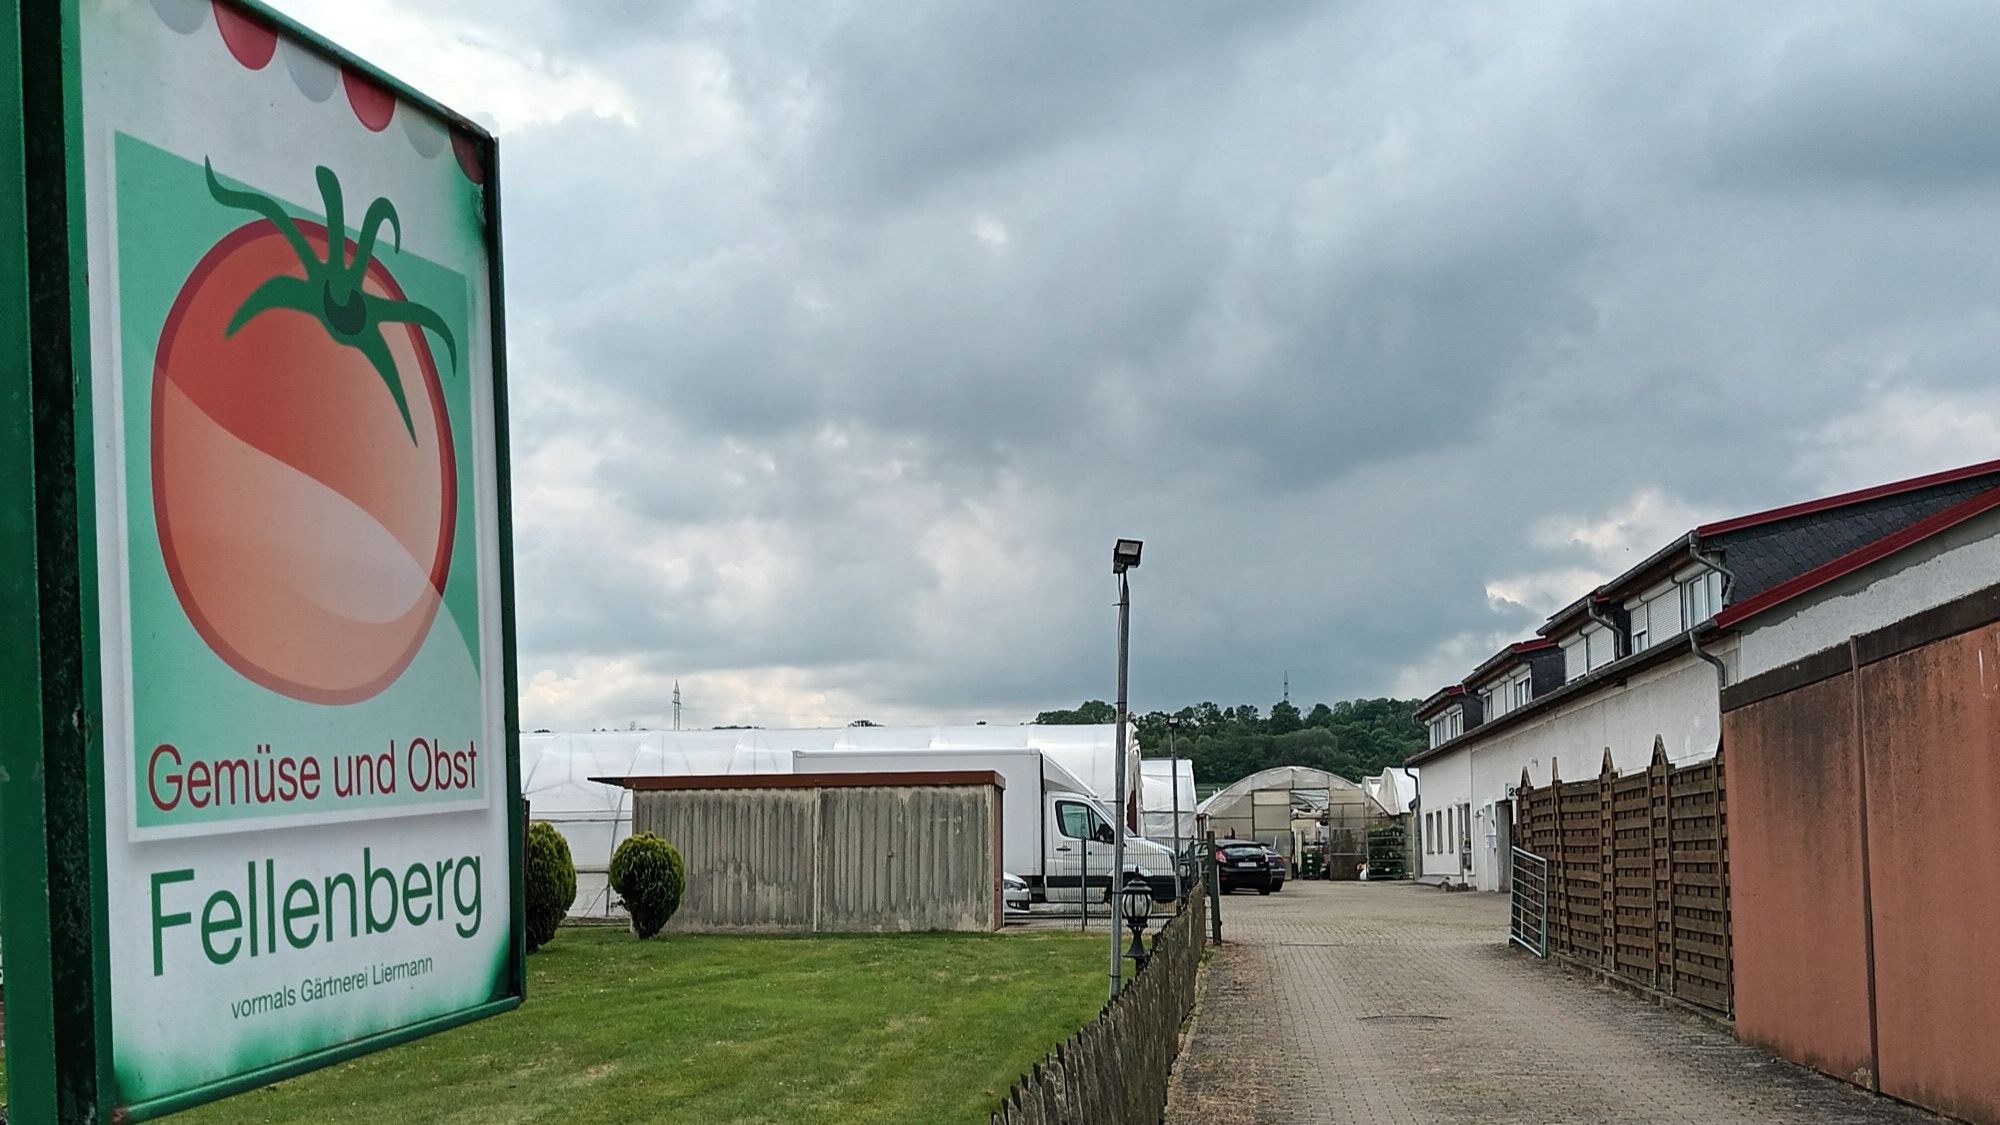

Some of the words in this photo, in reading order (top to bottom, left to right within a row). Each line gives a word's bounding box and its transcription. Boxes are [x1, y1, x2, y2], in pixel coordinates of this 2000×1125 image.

[148, 744, 321, 812] Gemüse
[334, 739, 396, 798] und
[407, 737, 477, 792] Obst
[150, 847, 482, 977] Fellenberg
[231, 985, 296, 1019] vormals
[301, 966, 368, 1003] Gärtnerei
[373, 957, 433, 985] Liermann
